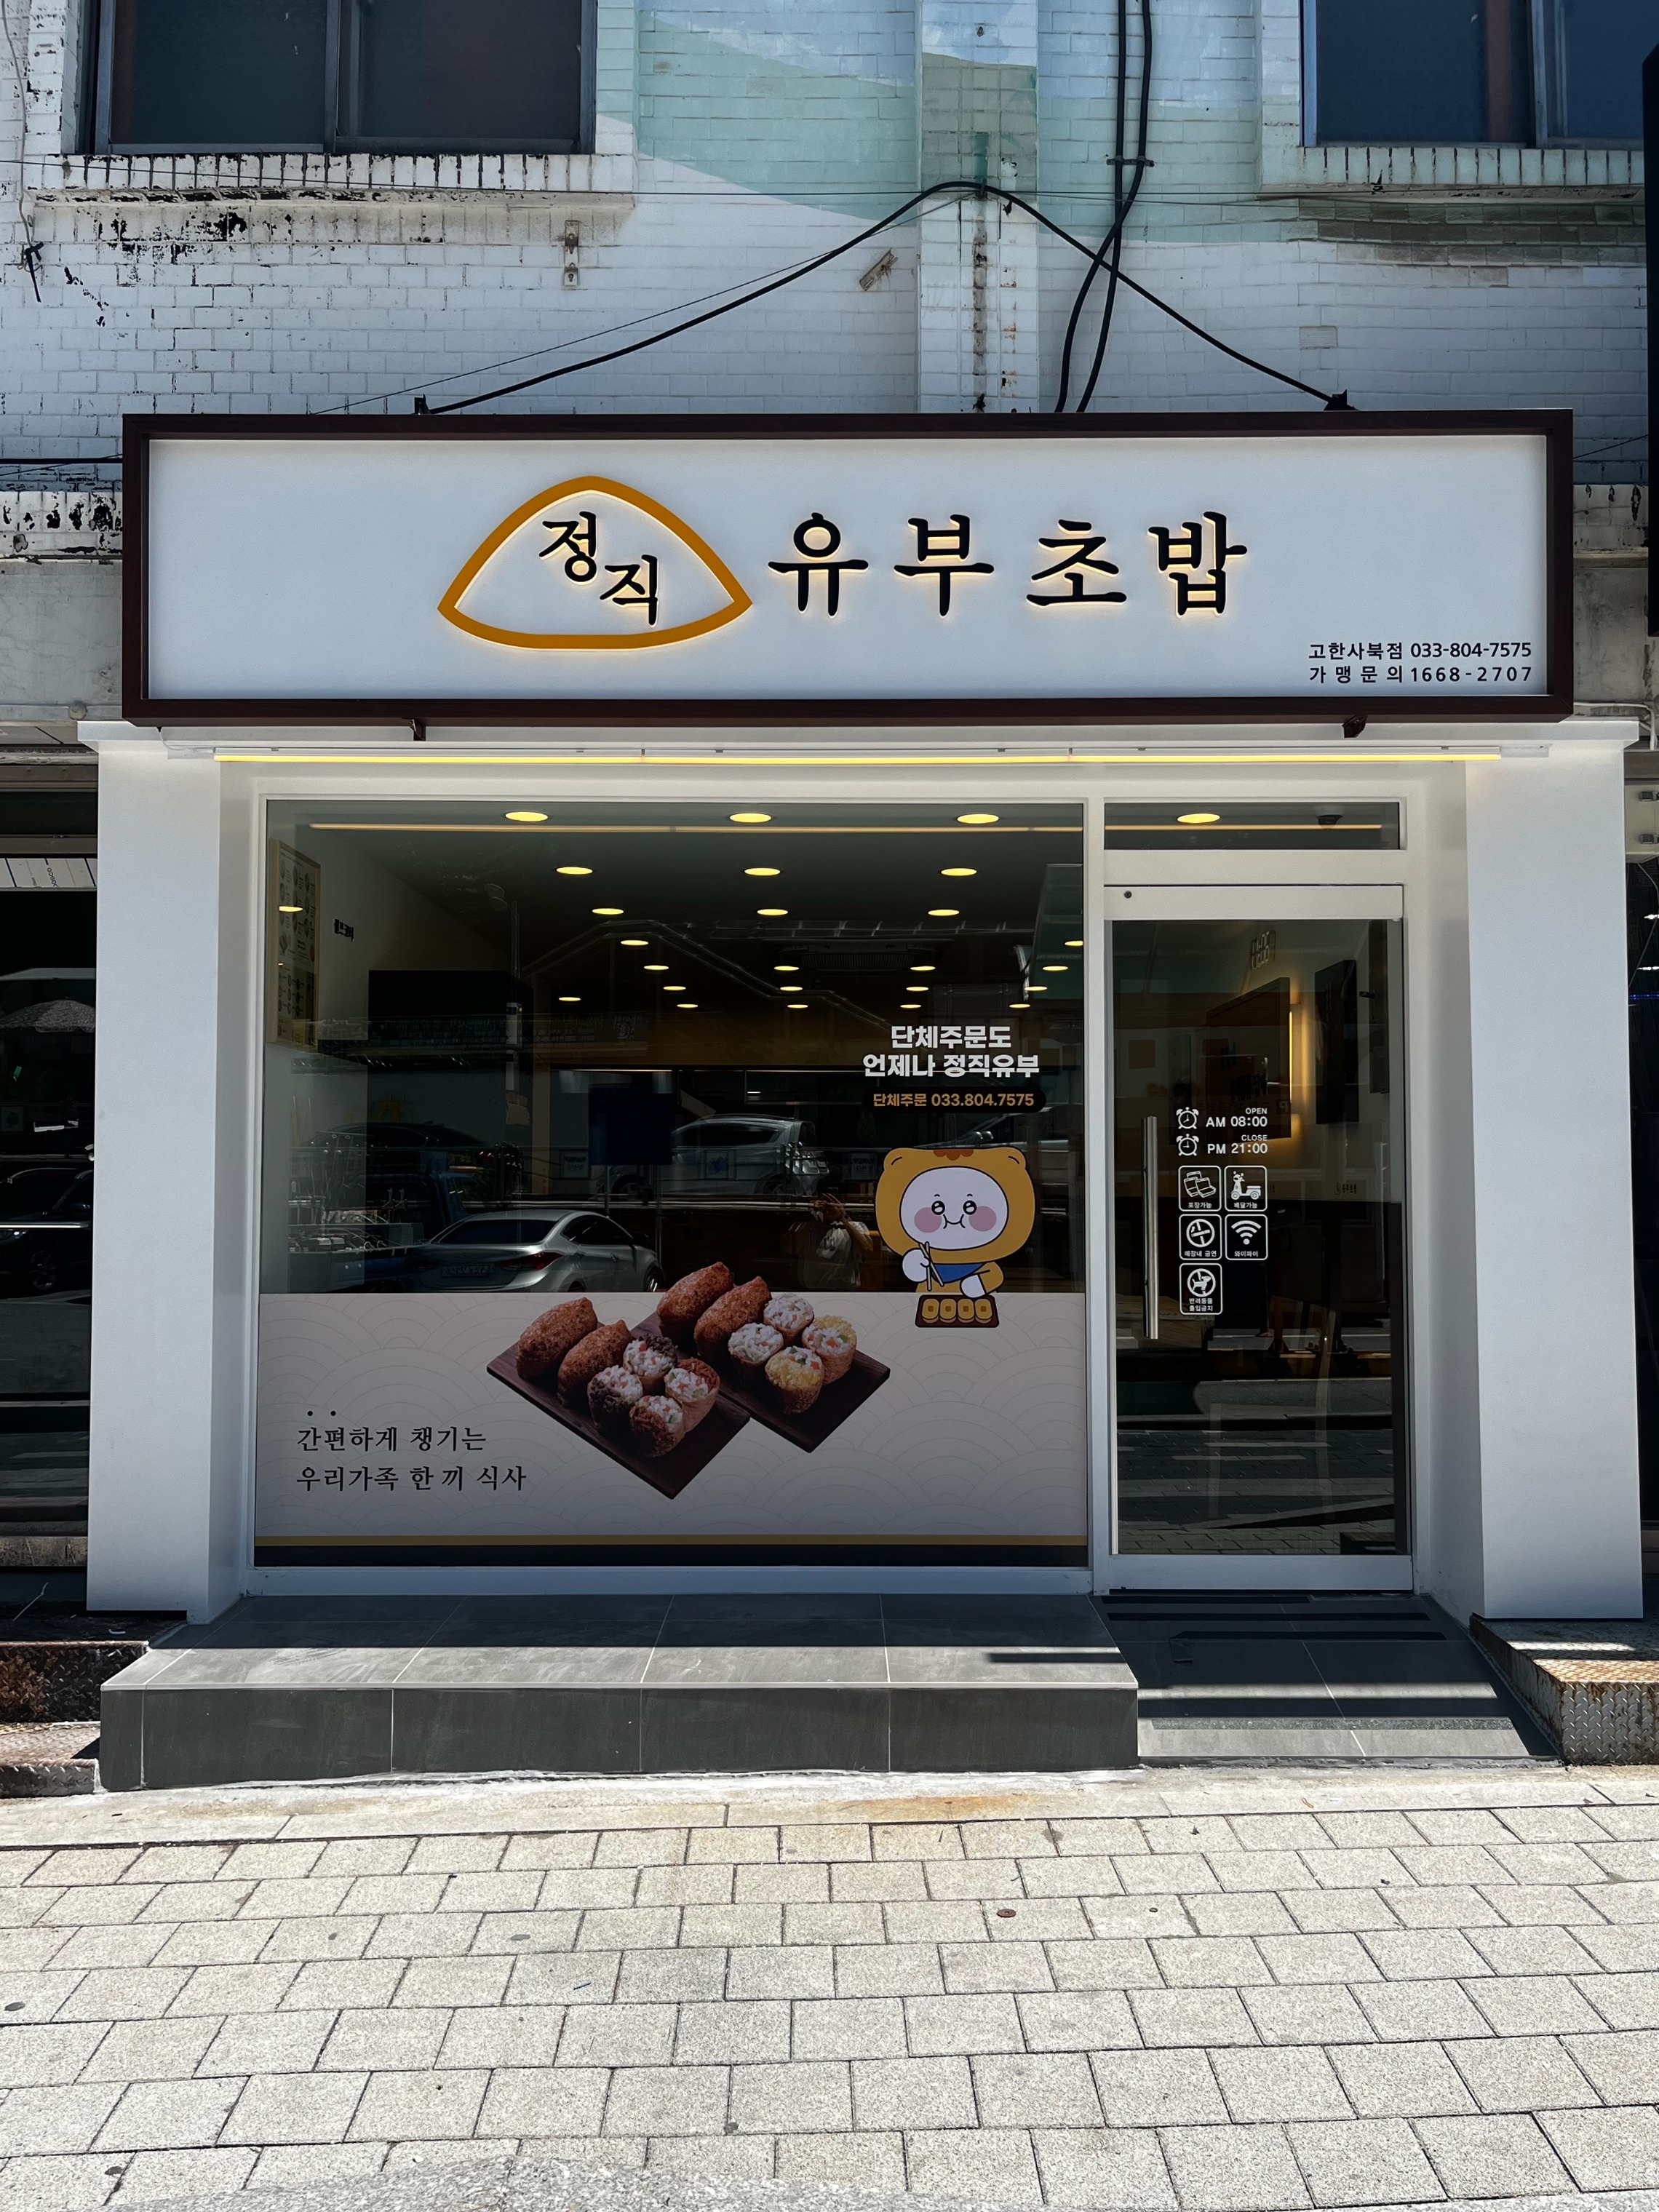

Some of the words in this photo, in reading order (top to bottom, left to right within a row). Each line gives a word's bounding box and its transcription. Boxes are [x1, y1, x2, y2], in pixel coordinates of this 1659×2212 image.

[539, 511, 658, 626] 정직
[768, 512, 1248, 617] 유부초밥
[1308, 642, 1403, 660] 고한사북점
[1410, 642, 1532, 658] 033-804-7575
[1411, 667, 1532, 682] 1668-2707
[891, 1025, 1011, 1049] 단체주문도
[862, 1054, 936, 1077] 언제나
[943, 1054, 1040, 1078] 정직유부
[873, 1094, 927, 1107] 단체주문
[931, 1094, 1034, 1107] 033.804.7575
[1206, 1117, 1226, 1127] AM
[1230, 1116, 1268, 1127] 08:00
[1207, 1144, 1226, 1154] PM
[1231, 1143, 1268, 1154] 21:00
[297, 1426, 398, 1452] 간편하게
[410, 1426, 486, 1452] 챙기는
[296, 1465, 399, 1491] 우리가족
[410, 1465, 434, 1491] 한
[441, 1465, 464, 1491] 끼
[477, 1465, 527, 1491] 식사
